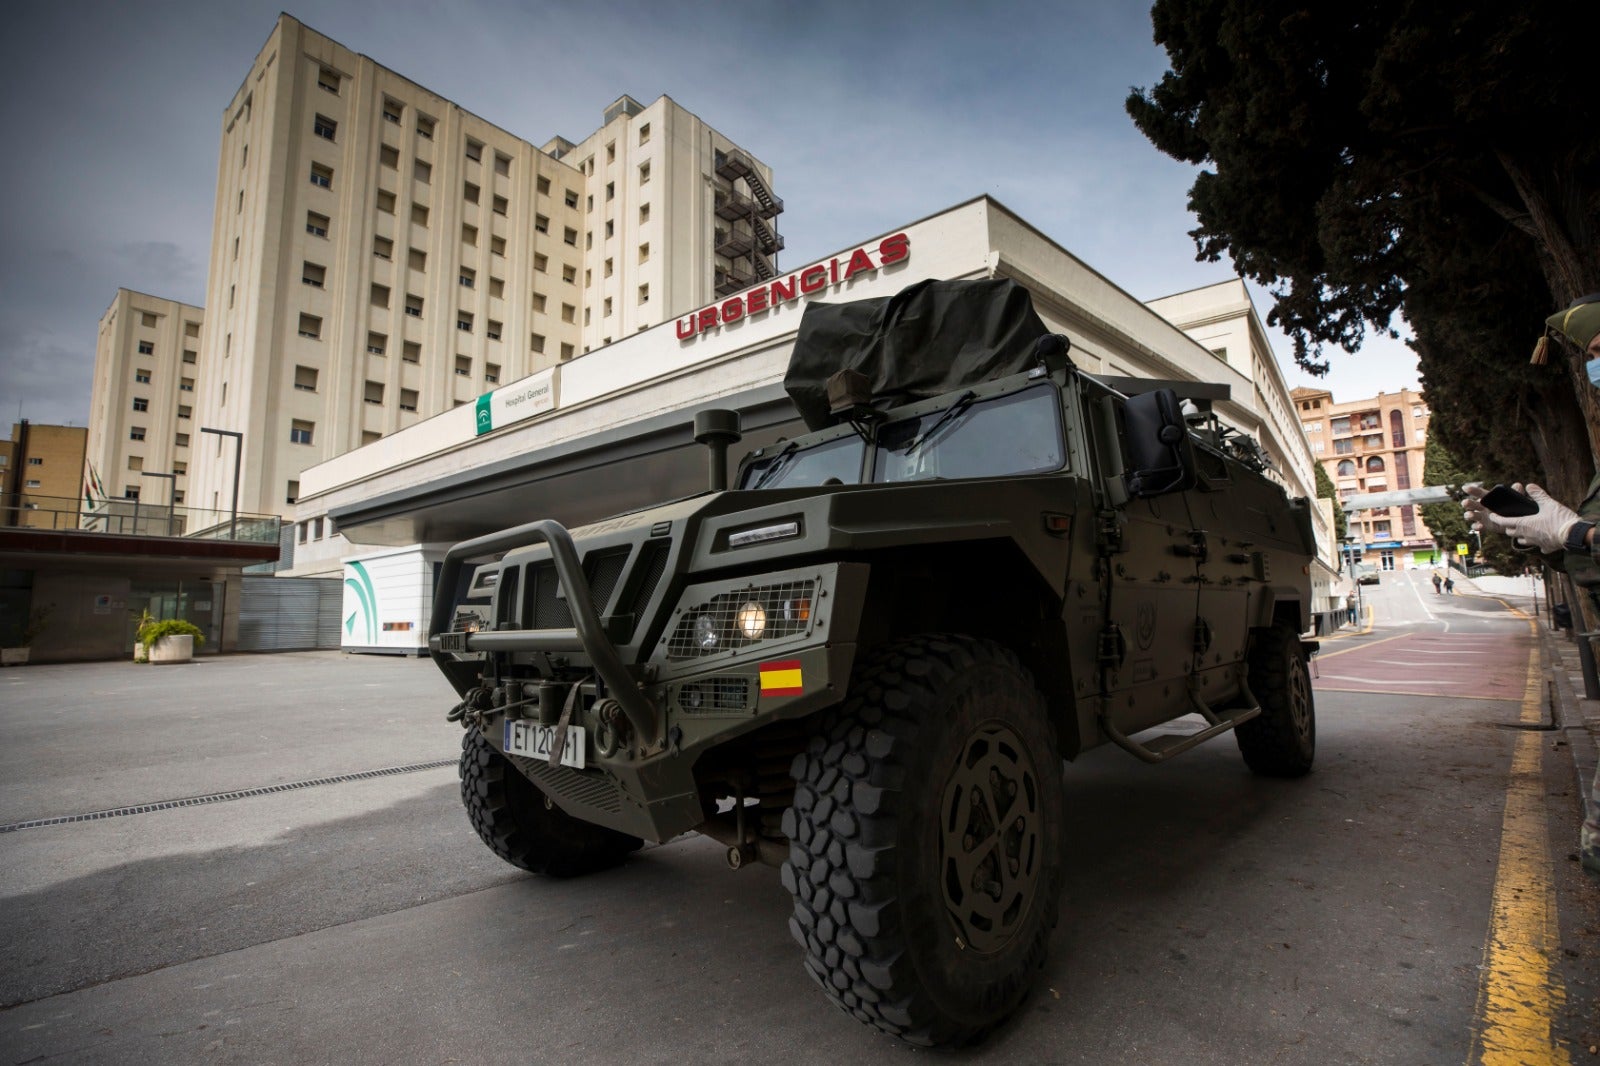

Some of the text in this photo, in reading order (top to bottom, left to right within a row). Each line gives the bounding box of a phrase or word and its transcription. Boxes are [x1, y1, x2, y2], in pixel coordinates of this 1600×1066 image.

[676, 232, 911, 341] URGENCIAS
[505, 393, 526, 408] Hospital
[527, 384, 550, 400] General
[571, 515, 645, 538] MTAC
[514, 723, 577, 762] ET1201
